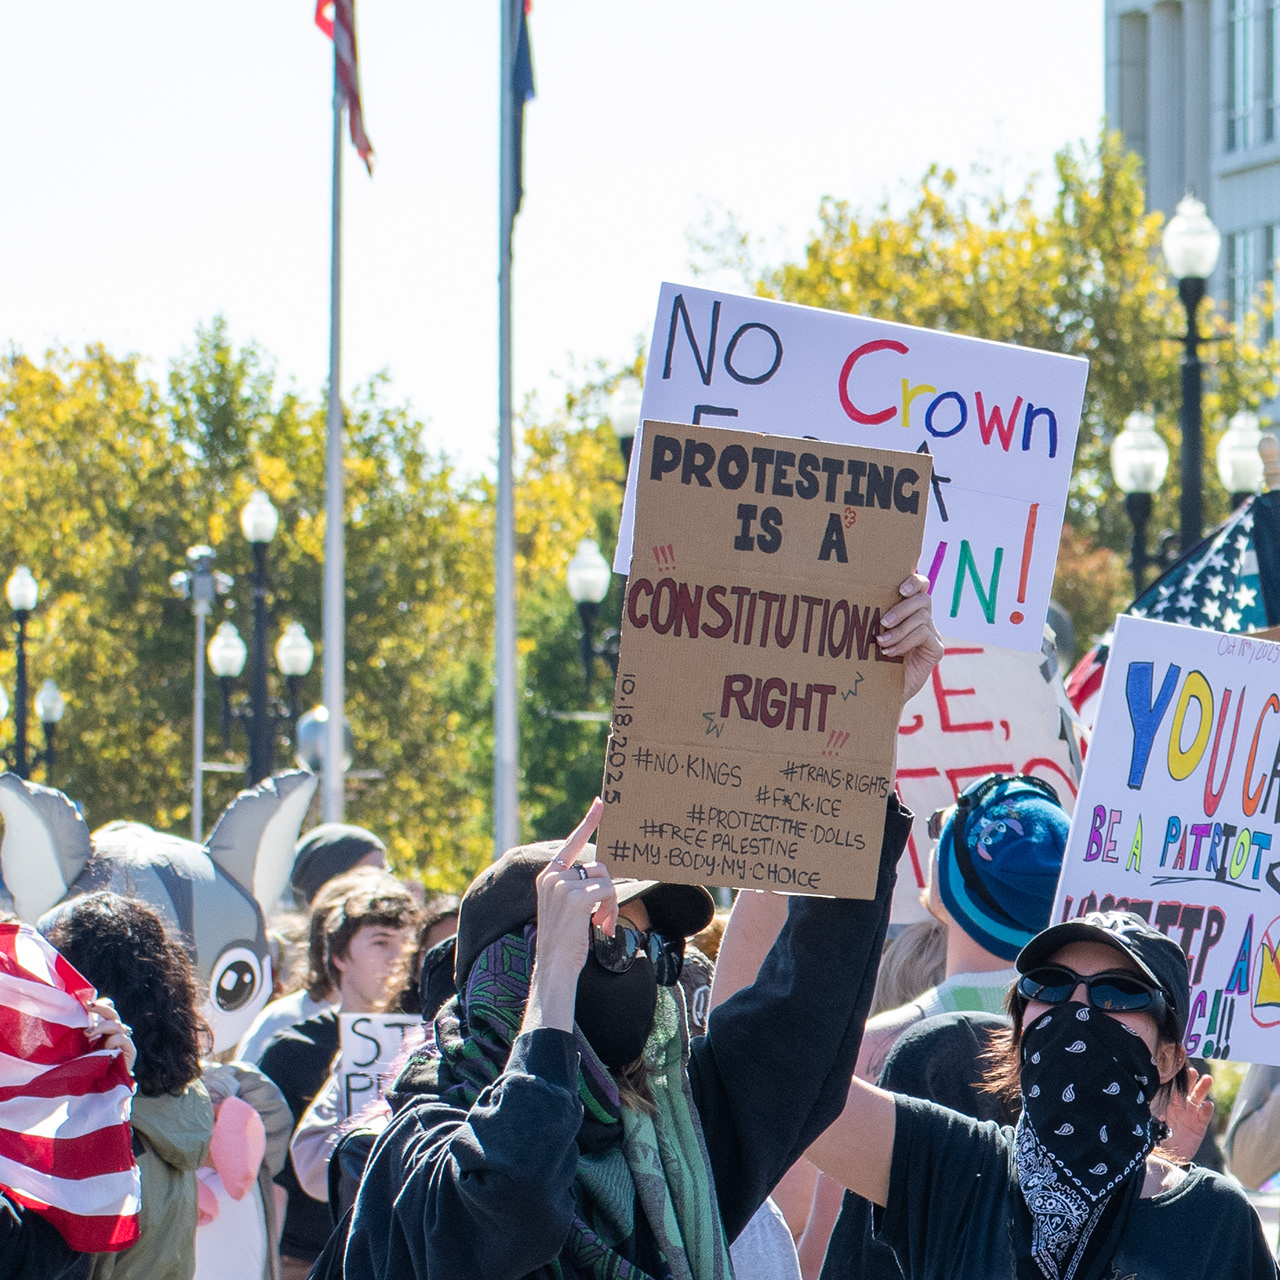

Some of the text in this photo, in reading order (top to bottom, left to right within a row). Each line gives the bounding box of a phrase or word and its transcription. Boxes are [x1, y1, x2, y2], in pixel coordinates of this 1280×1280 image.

[662, 293, 1057, 459] NO Crown
[649, 435, 920, 516] PROTESTING
[733, 503, 848, 563] IS A
[604, 673, 637, 805] 10.18.2025
[720, 673, 836, 733] RIGHT
[1126, 661, 1246, 817] YOU
[639, 819, 798, 860] #FREE PALESTINE
[1083, 804, 1122, 863] BE
[1126, 813, 1144, 874] A
[1159, 815, 1272, 883] PATRIOT
[1225, 913, 1254, 996] A
